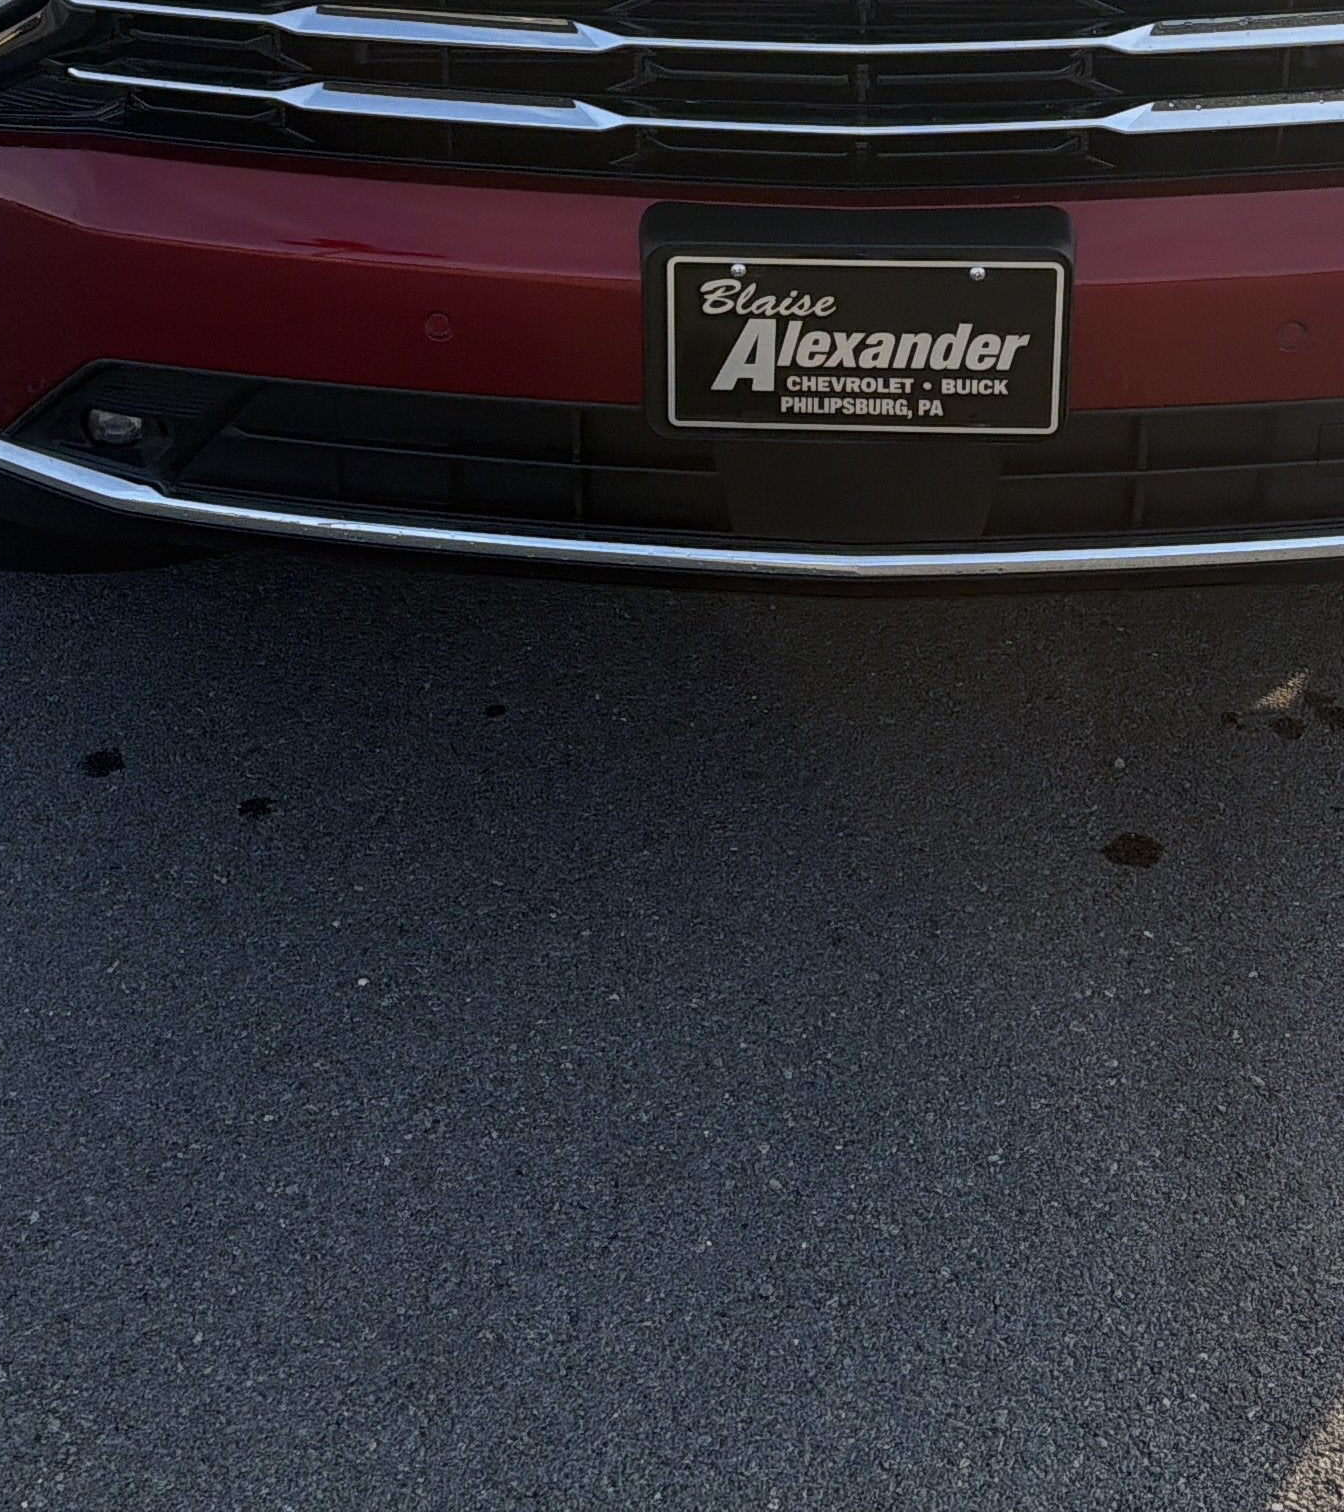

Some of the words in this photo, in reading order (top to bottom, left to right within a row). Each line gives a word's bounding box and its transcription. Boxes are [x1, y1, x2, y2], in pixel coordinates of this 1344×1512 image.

[699, 278, 837, 318] Blaise
[710, 318, 1031, 393] Alexander
[786, 375, 915, 395] CHEVROLET
[941, 378, 1009, 396] BUICK
[780, 397, 913, 420] PHILIPSBURG,
[917, 399, 944, 417] PA
